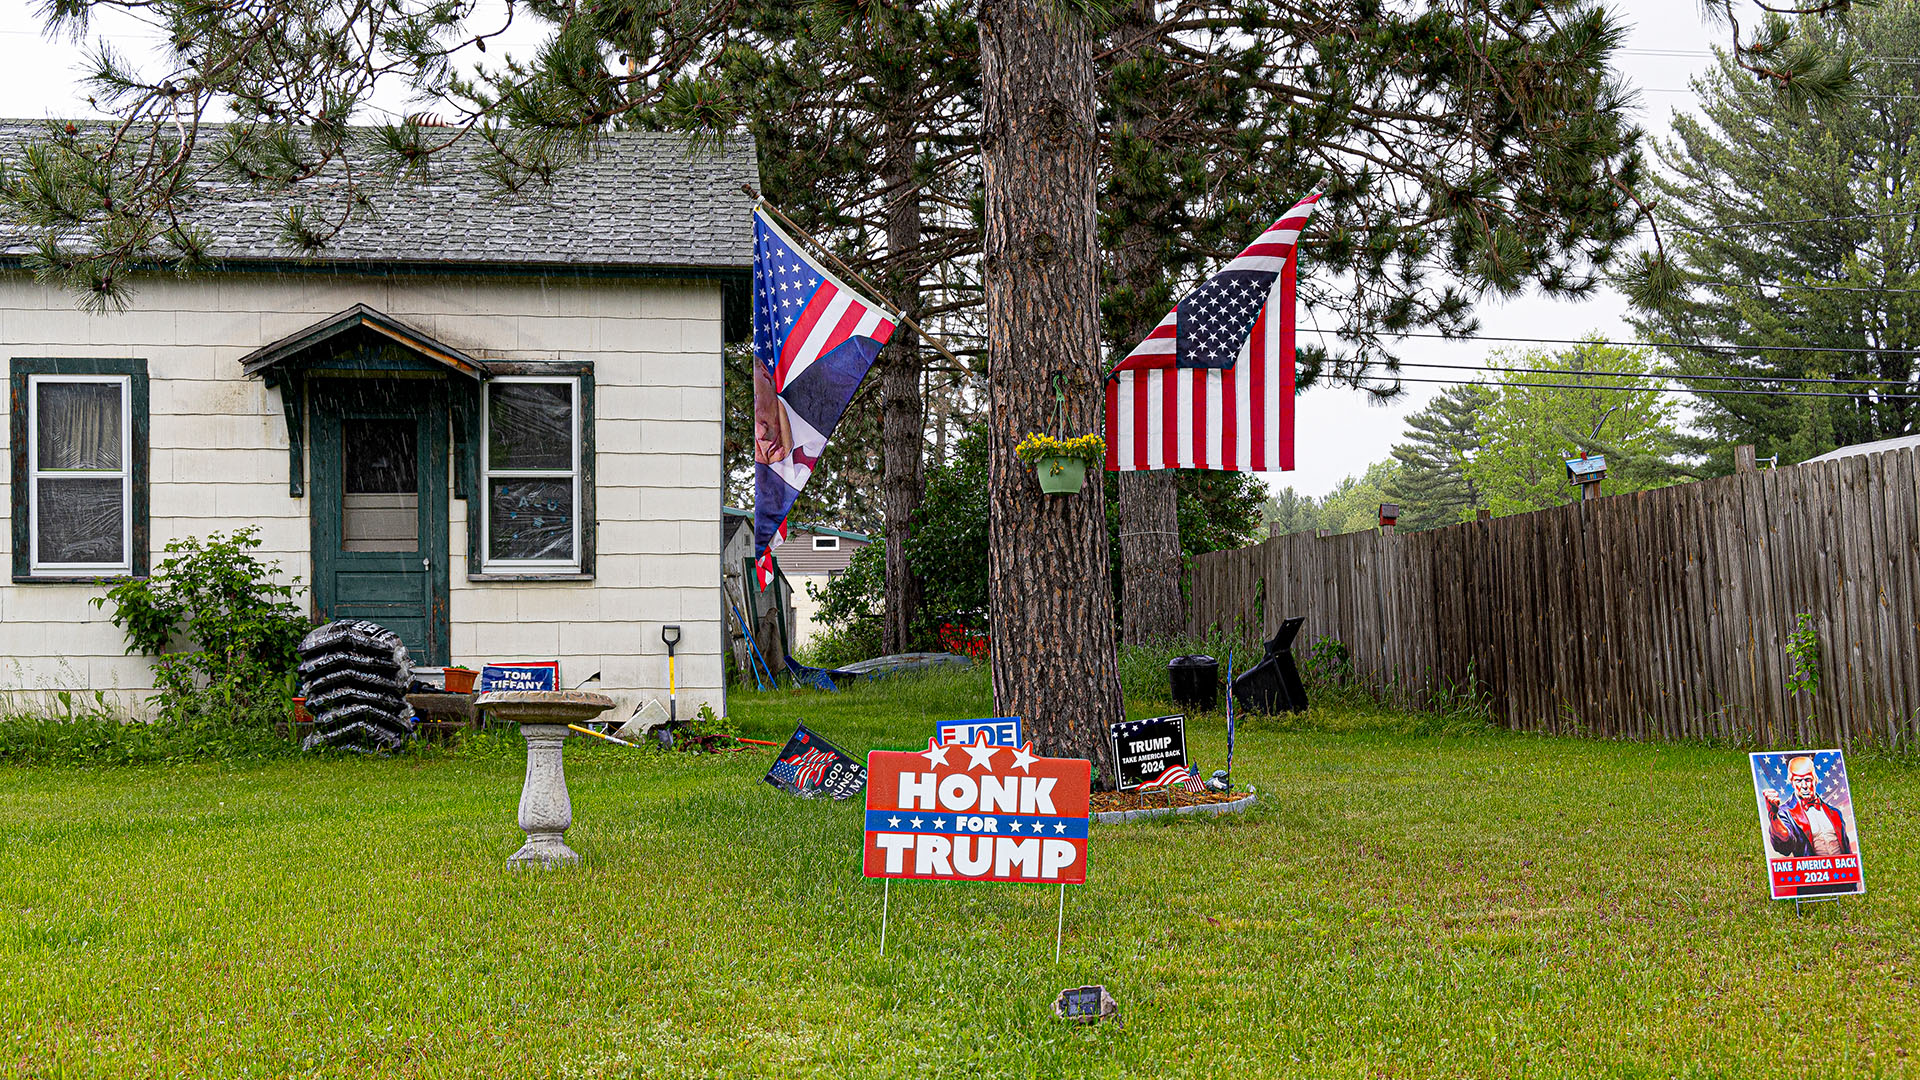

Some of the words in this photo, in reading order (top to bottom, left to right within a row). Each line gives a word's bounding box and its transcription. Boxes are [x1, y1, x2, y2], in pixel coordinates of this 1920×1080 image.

[503, 671, 532, 680] TOM
[490, 680, 543, 690] TIFFANY
[1129, 737, 1171, 754] TRUMP
[1122, 756, 1138, 764] TAKE
[1138, 753, 1164, 761] AMERICA
[1165, 749, 1181, 758] BACK
[849, 763, 860, 772] &
[1141, 760, 1165, 774] 2024
[824, 763, 843, 787] GOD
[898, 771, 1058, 815] HONK
[955, 816, 998, 833] FOR
[876, 833, 1077, 879] TRUMP
[1772, 861, 1794, 873] TAKE
[1796, 859, 1833, 872] AMERICA
[1834, 857, 1857, 869] BACK
[1804, 871, 1830, 883] 2024
